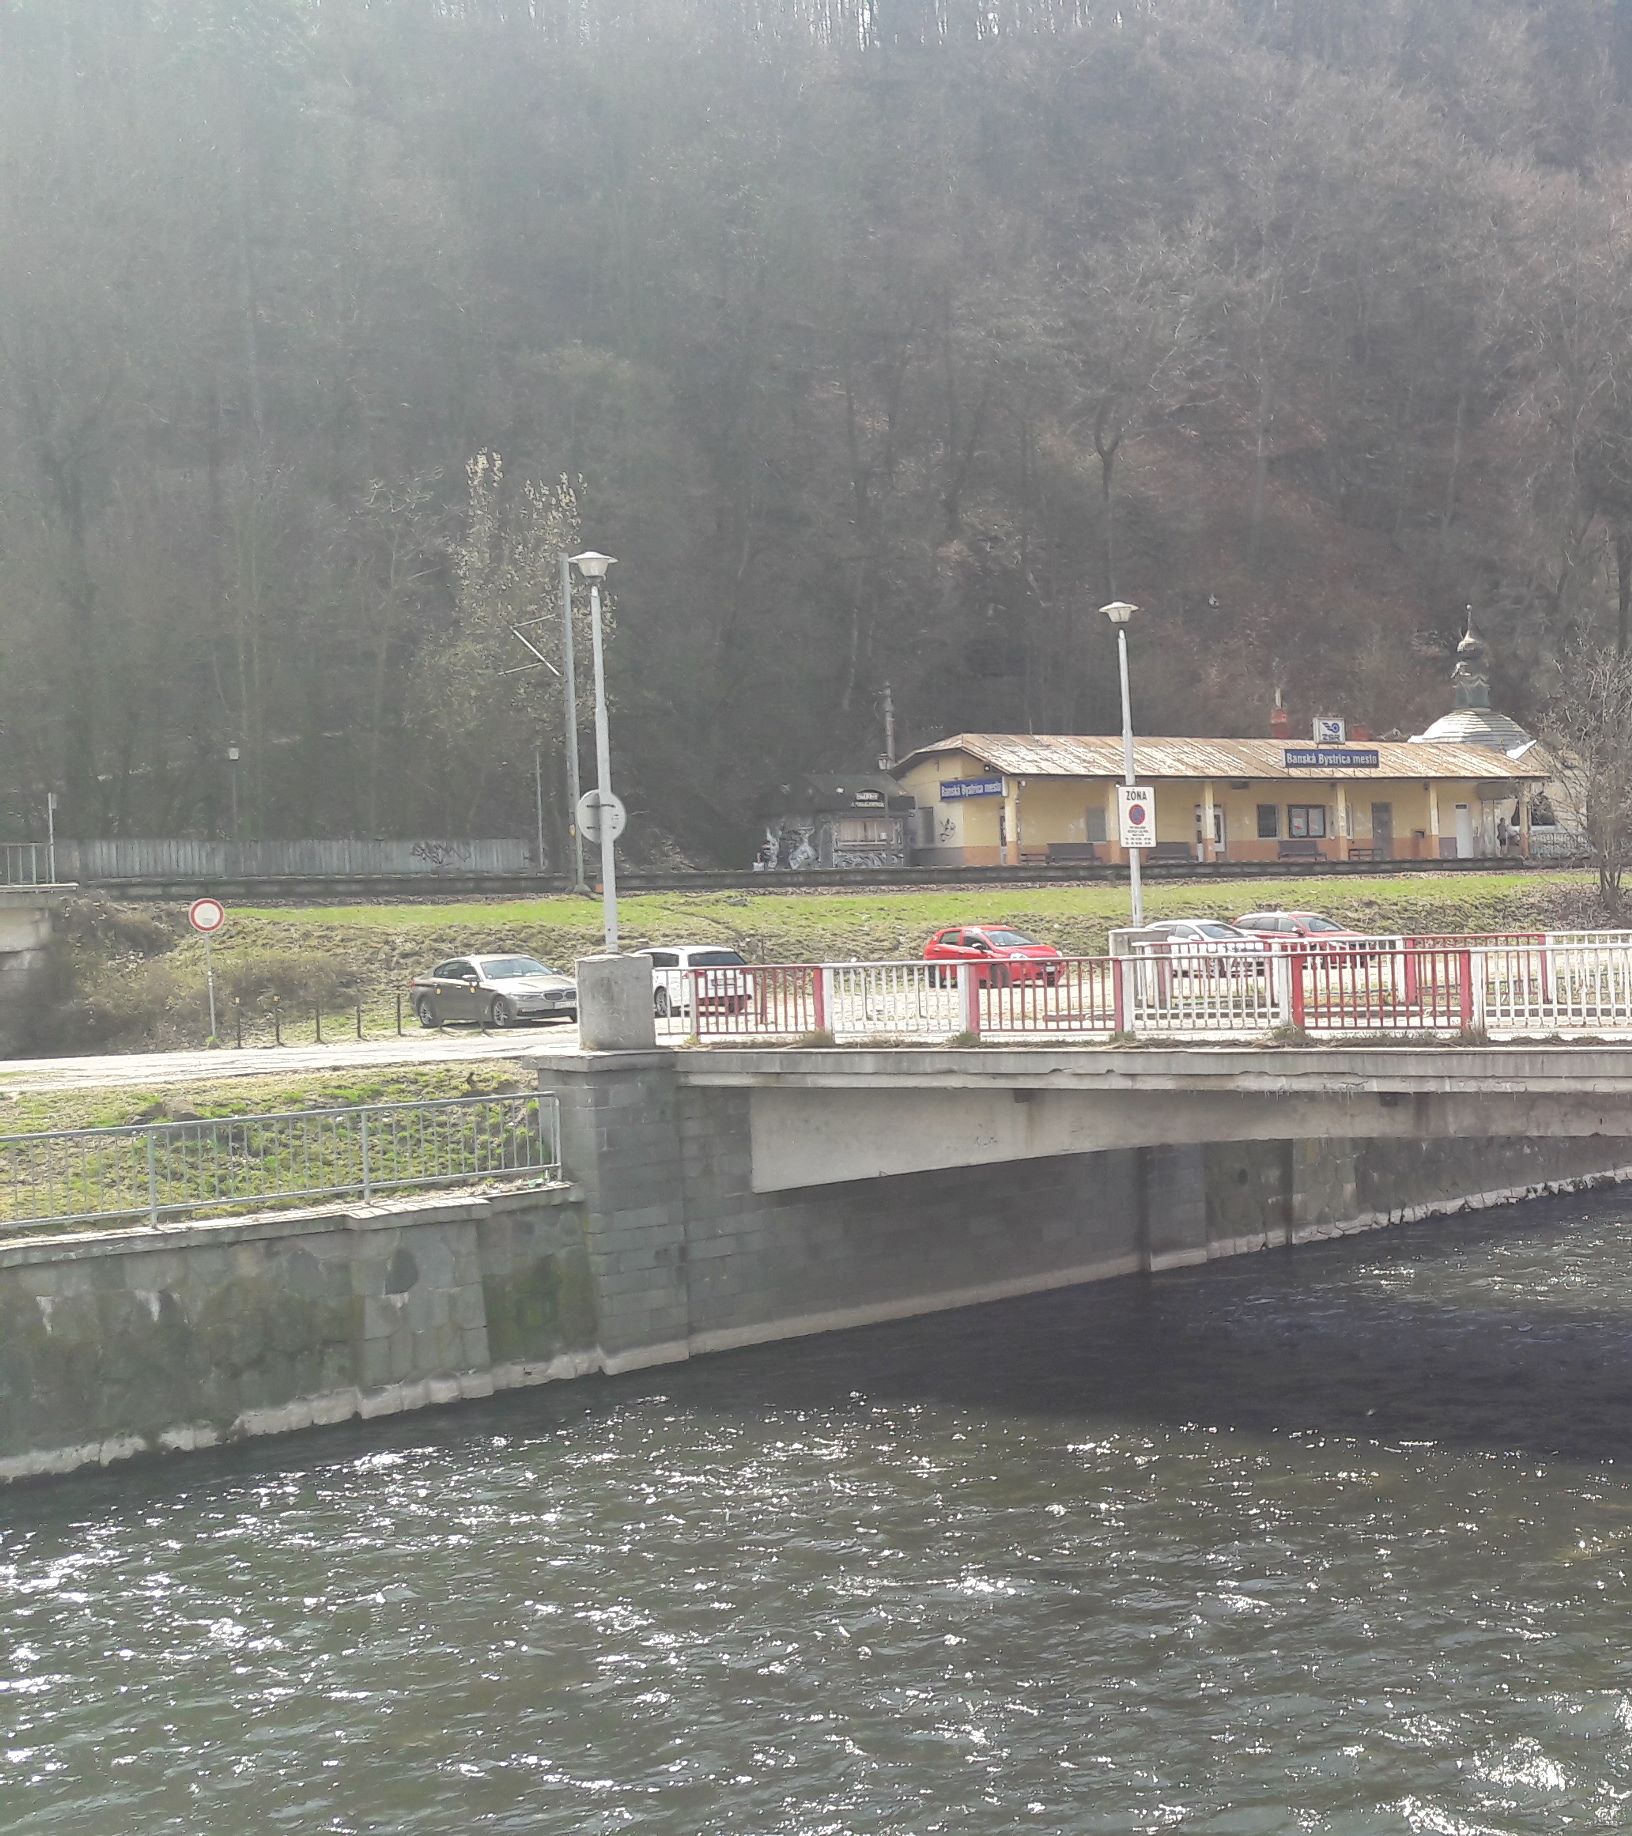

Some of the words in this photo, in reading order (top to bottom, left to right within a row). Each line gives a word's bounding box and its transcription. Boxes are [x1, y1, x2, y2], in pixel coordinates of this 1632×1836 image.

[1286, 753, 1316, 764] Banská
[1318, 754, 1351, 766] Bystrica
[1353, 754, 1377, 764] mesto
[1126, 788, 1147, 801] ZÓNA
